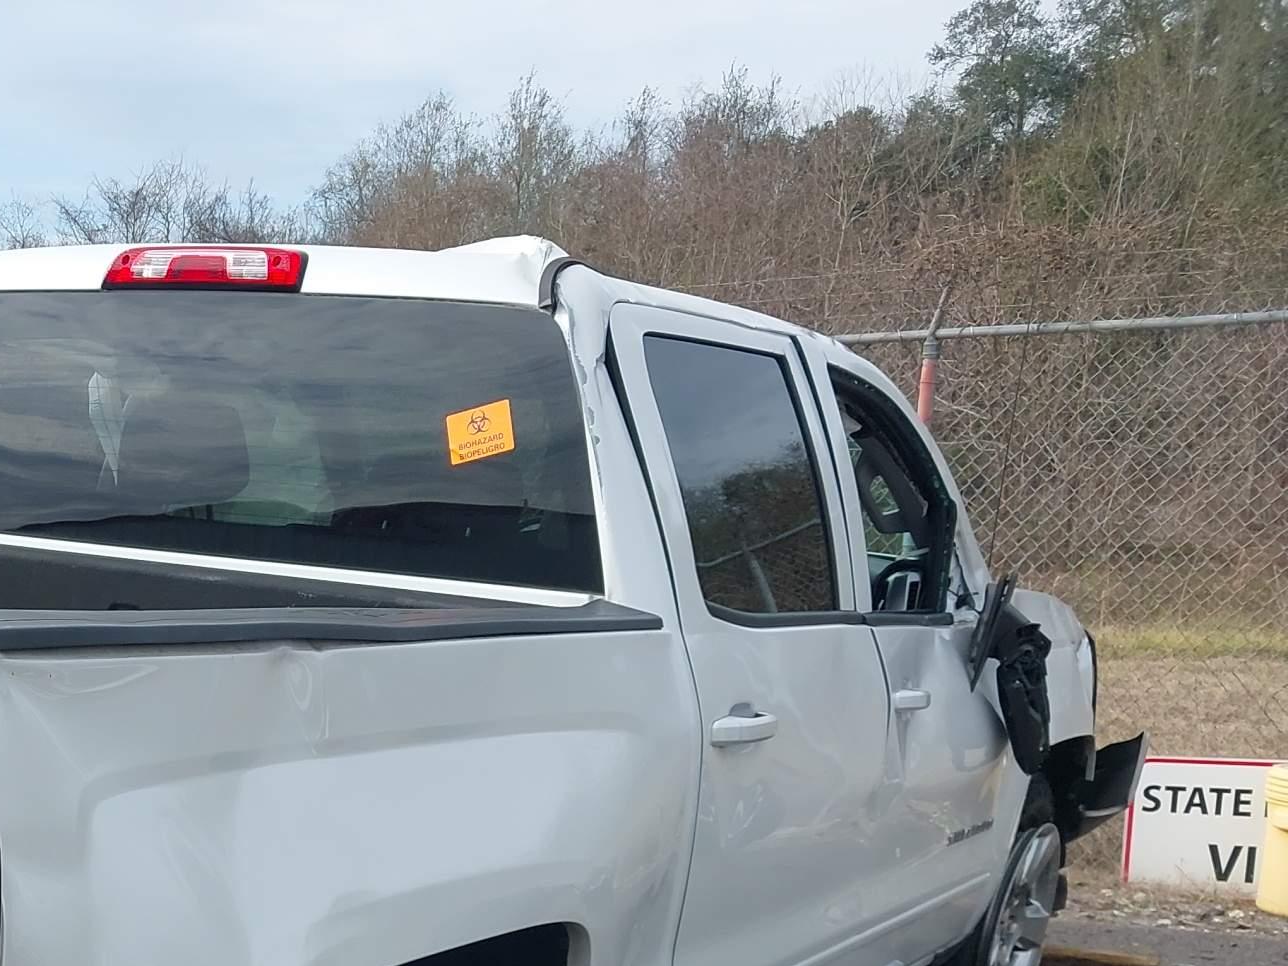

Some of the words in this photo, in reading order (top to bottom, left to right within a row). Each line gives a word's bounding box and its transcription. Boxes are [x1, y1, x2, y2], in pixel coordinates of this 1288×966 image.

[458, 432, 504, 450] BIOHAZARD
[459, 442, 505, 461] BIOPELIGRO
[1142, 785, 1253, 817] STATE
